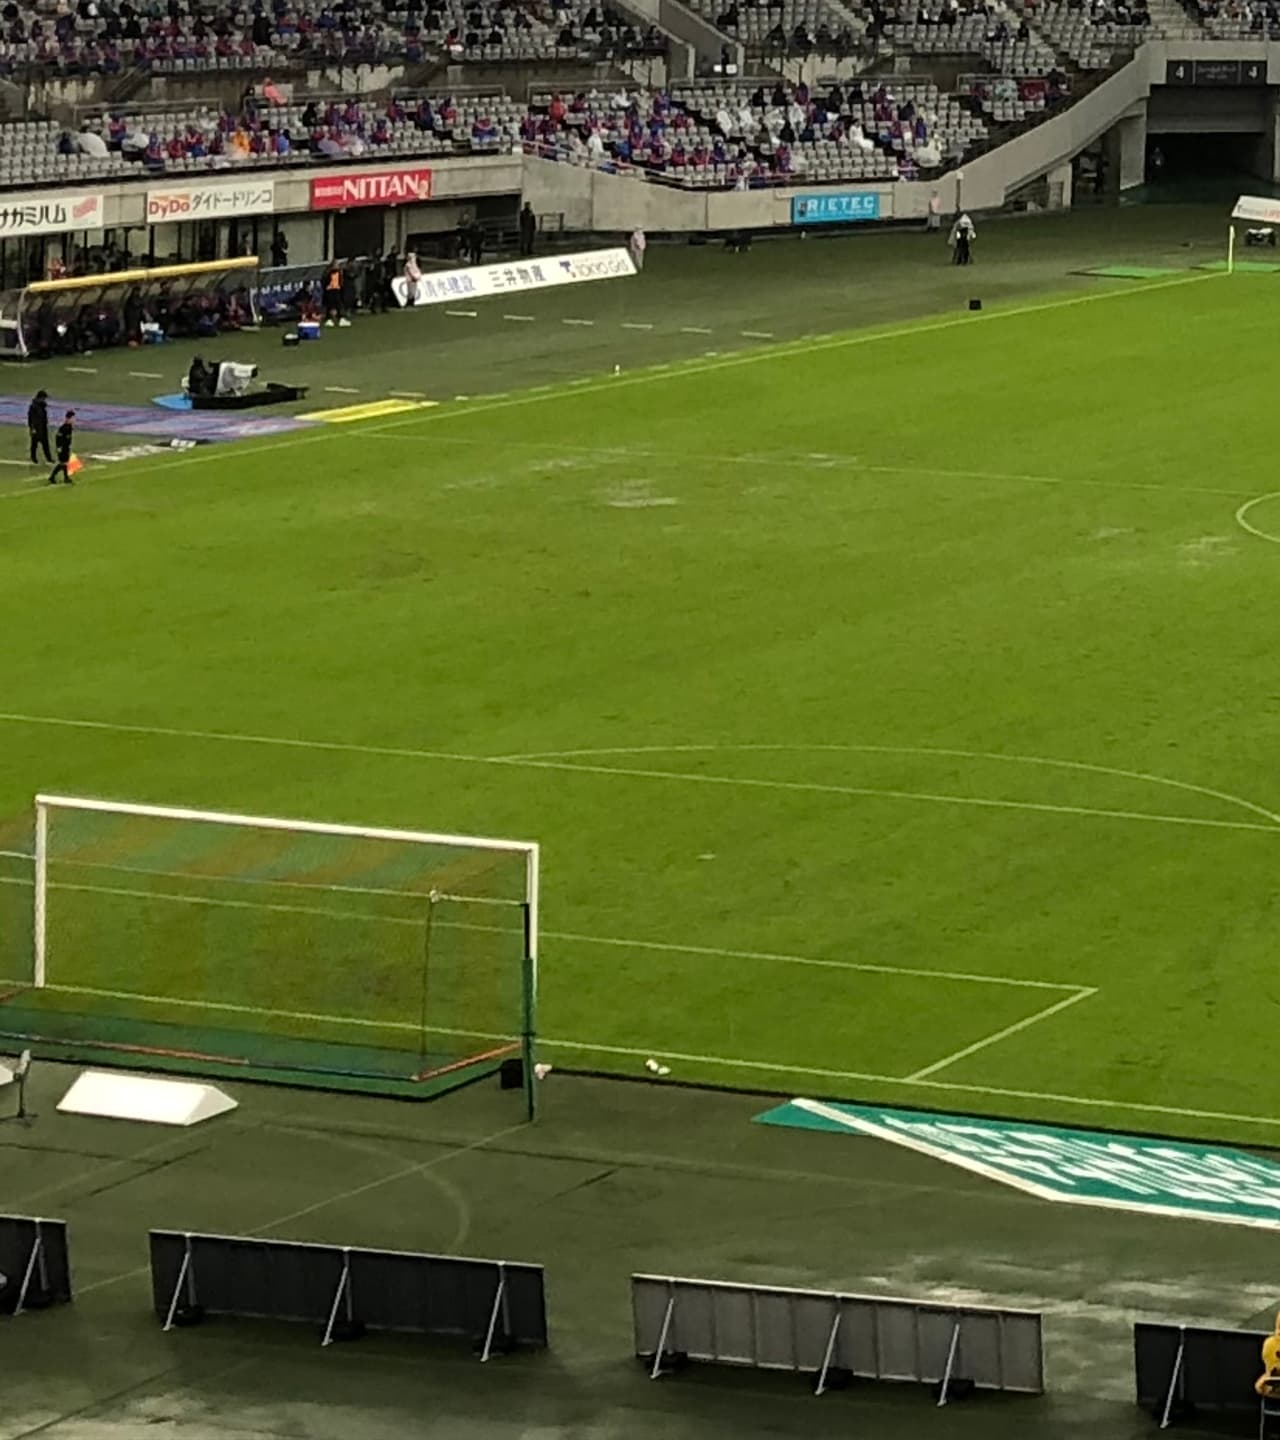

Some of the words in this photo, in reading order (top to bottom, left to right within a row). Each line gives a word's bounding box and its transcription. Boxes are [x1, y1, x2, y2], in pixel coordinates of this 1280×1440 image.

[342, 174, 419, 201] NITTAN
[149, 200, 190, 218] DyDo
[192, 189, 273, 210] ダイドードリンコ
[488, 264, 547, 288] 三井物産
